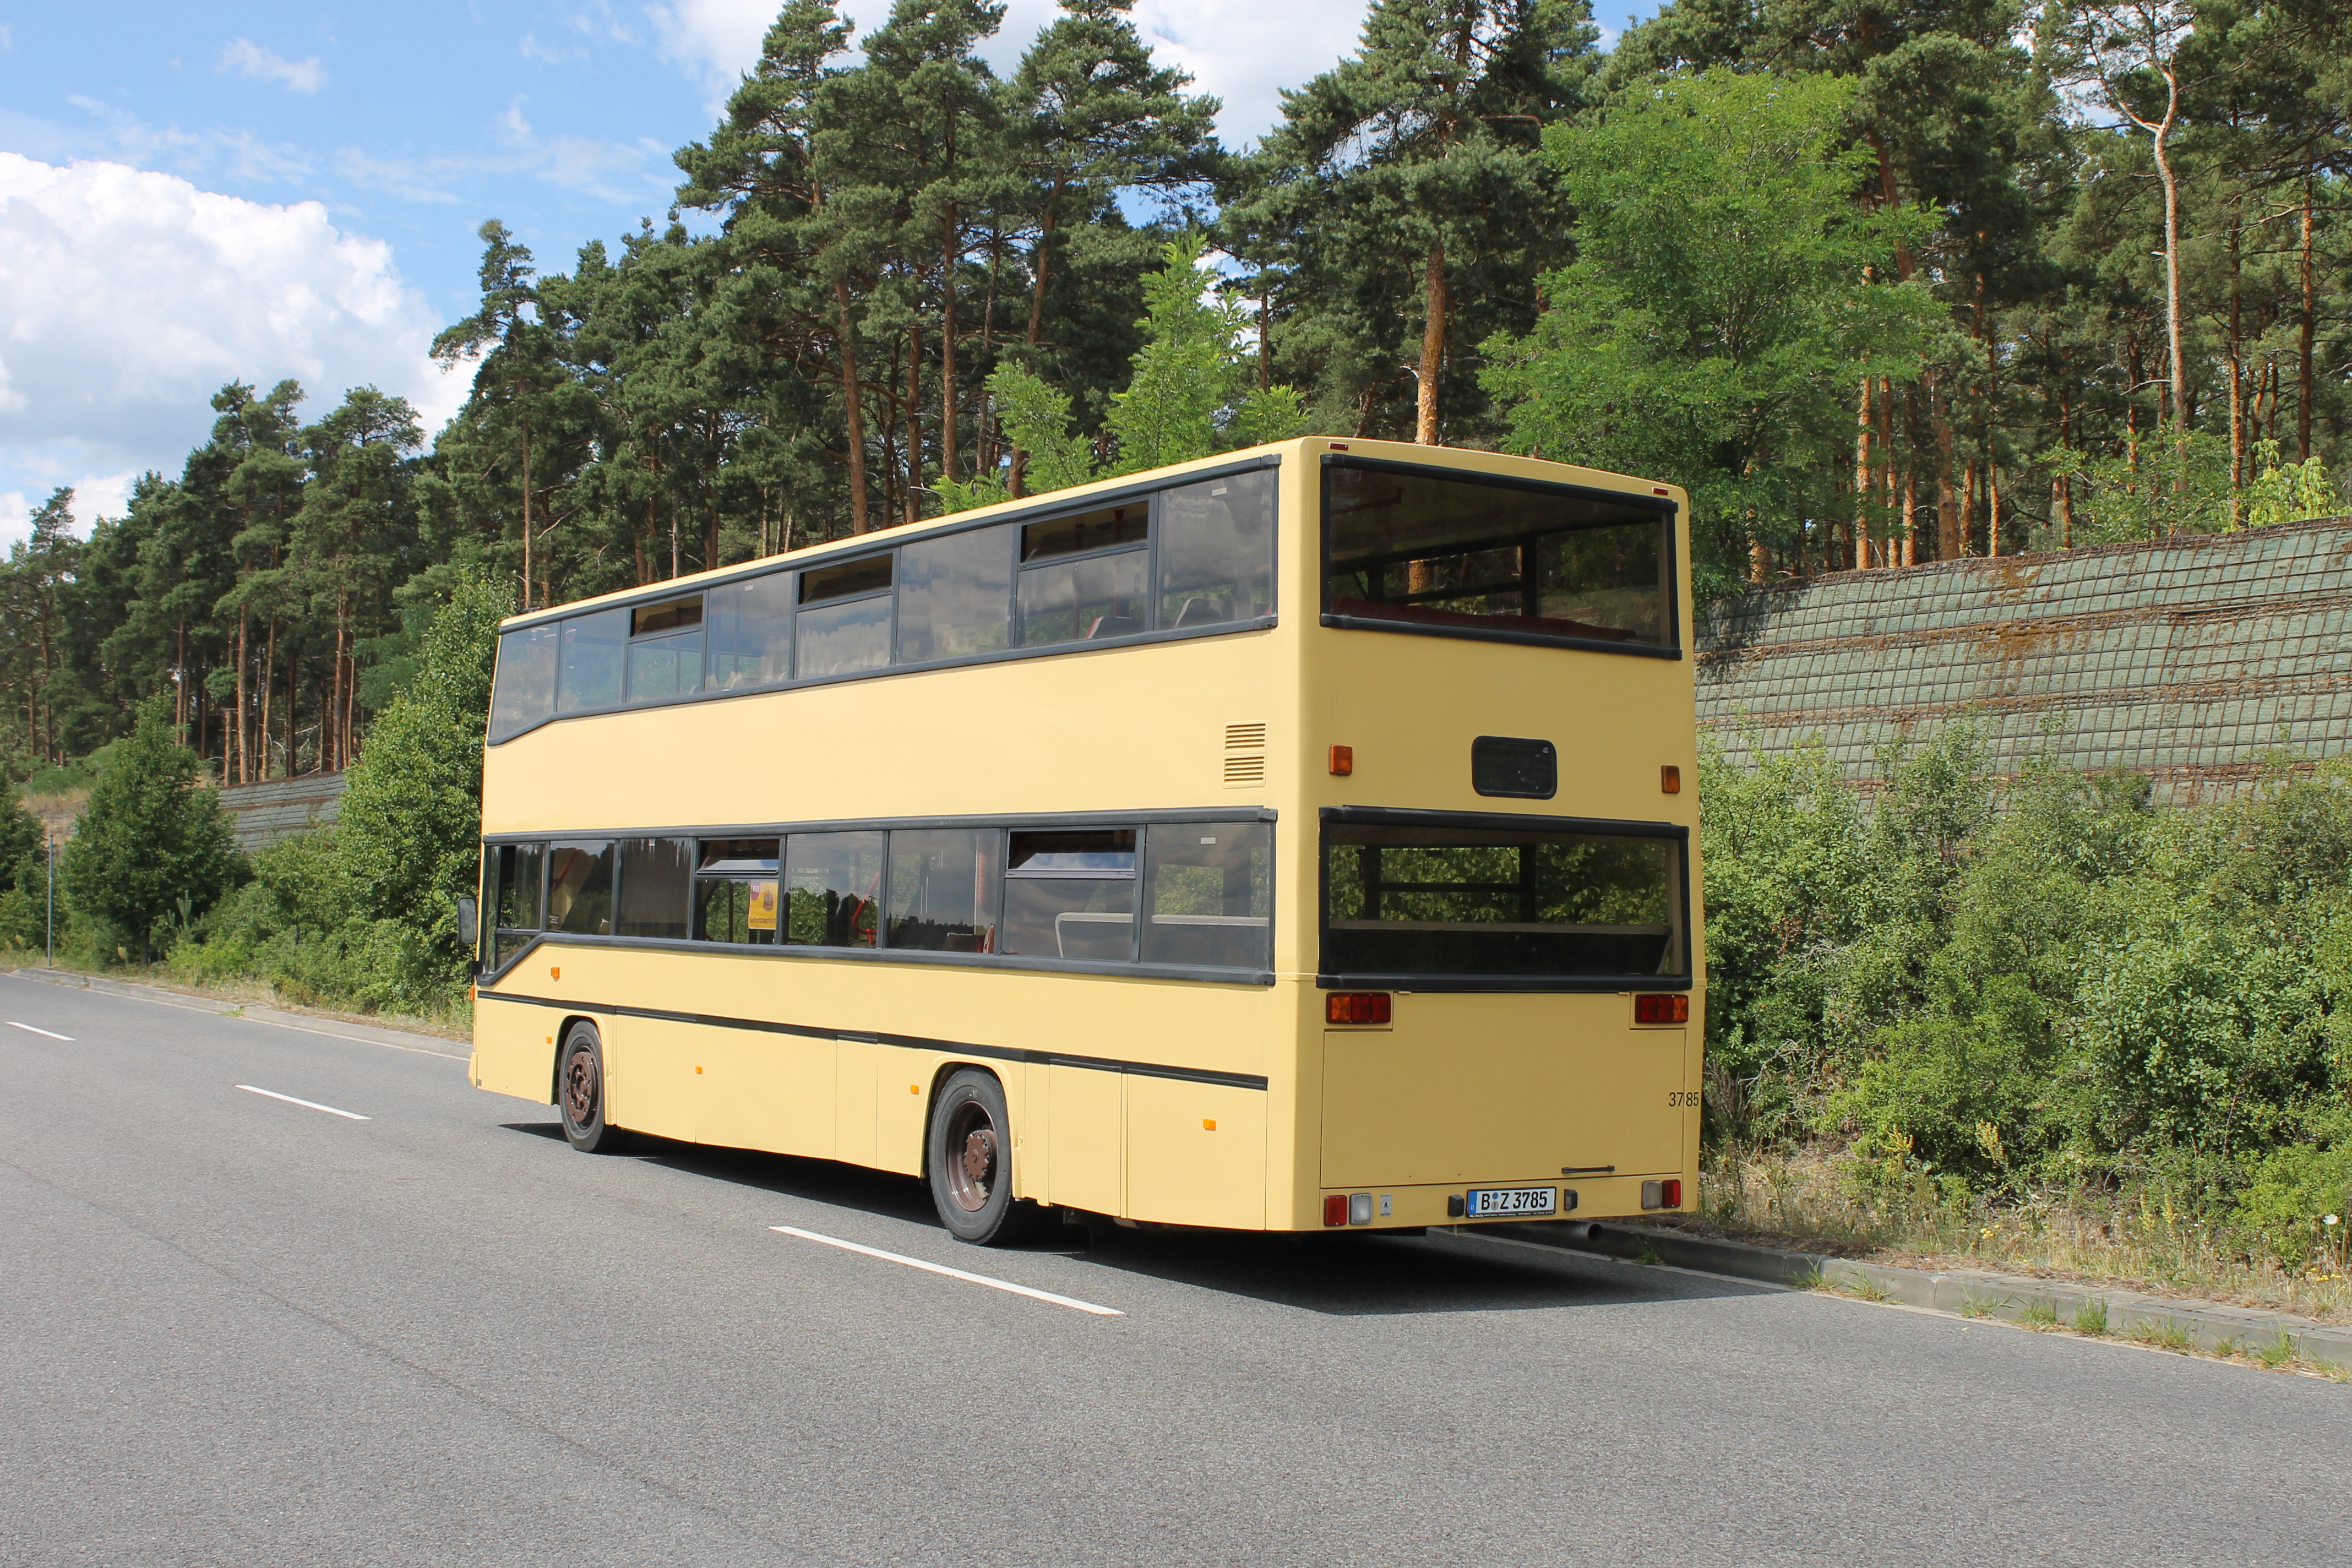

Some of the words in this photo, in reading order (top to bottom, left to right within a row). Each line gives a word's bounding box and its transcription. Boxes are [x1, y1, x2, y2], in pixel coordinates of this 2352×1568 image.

[1669, 1092, 1699, 1107] 3785
[1481, 1193, 1490, 1210] B
[1500, 1193, 1509, 1210] Z
[1513, 1191, 1548, 1209] 3785
